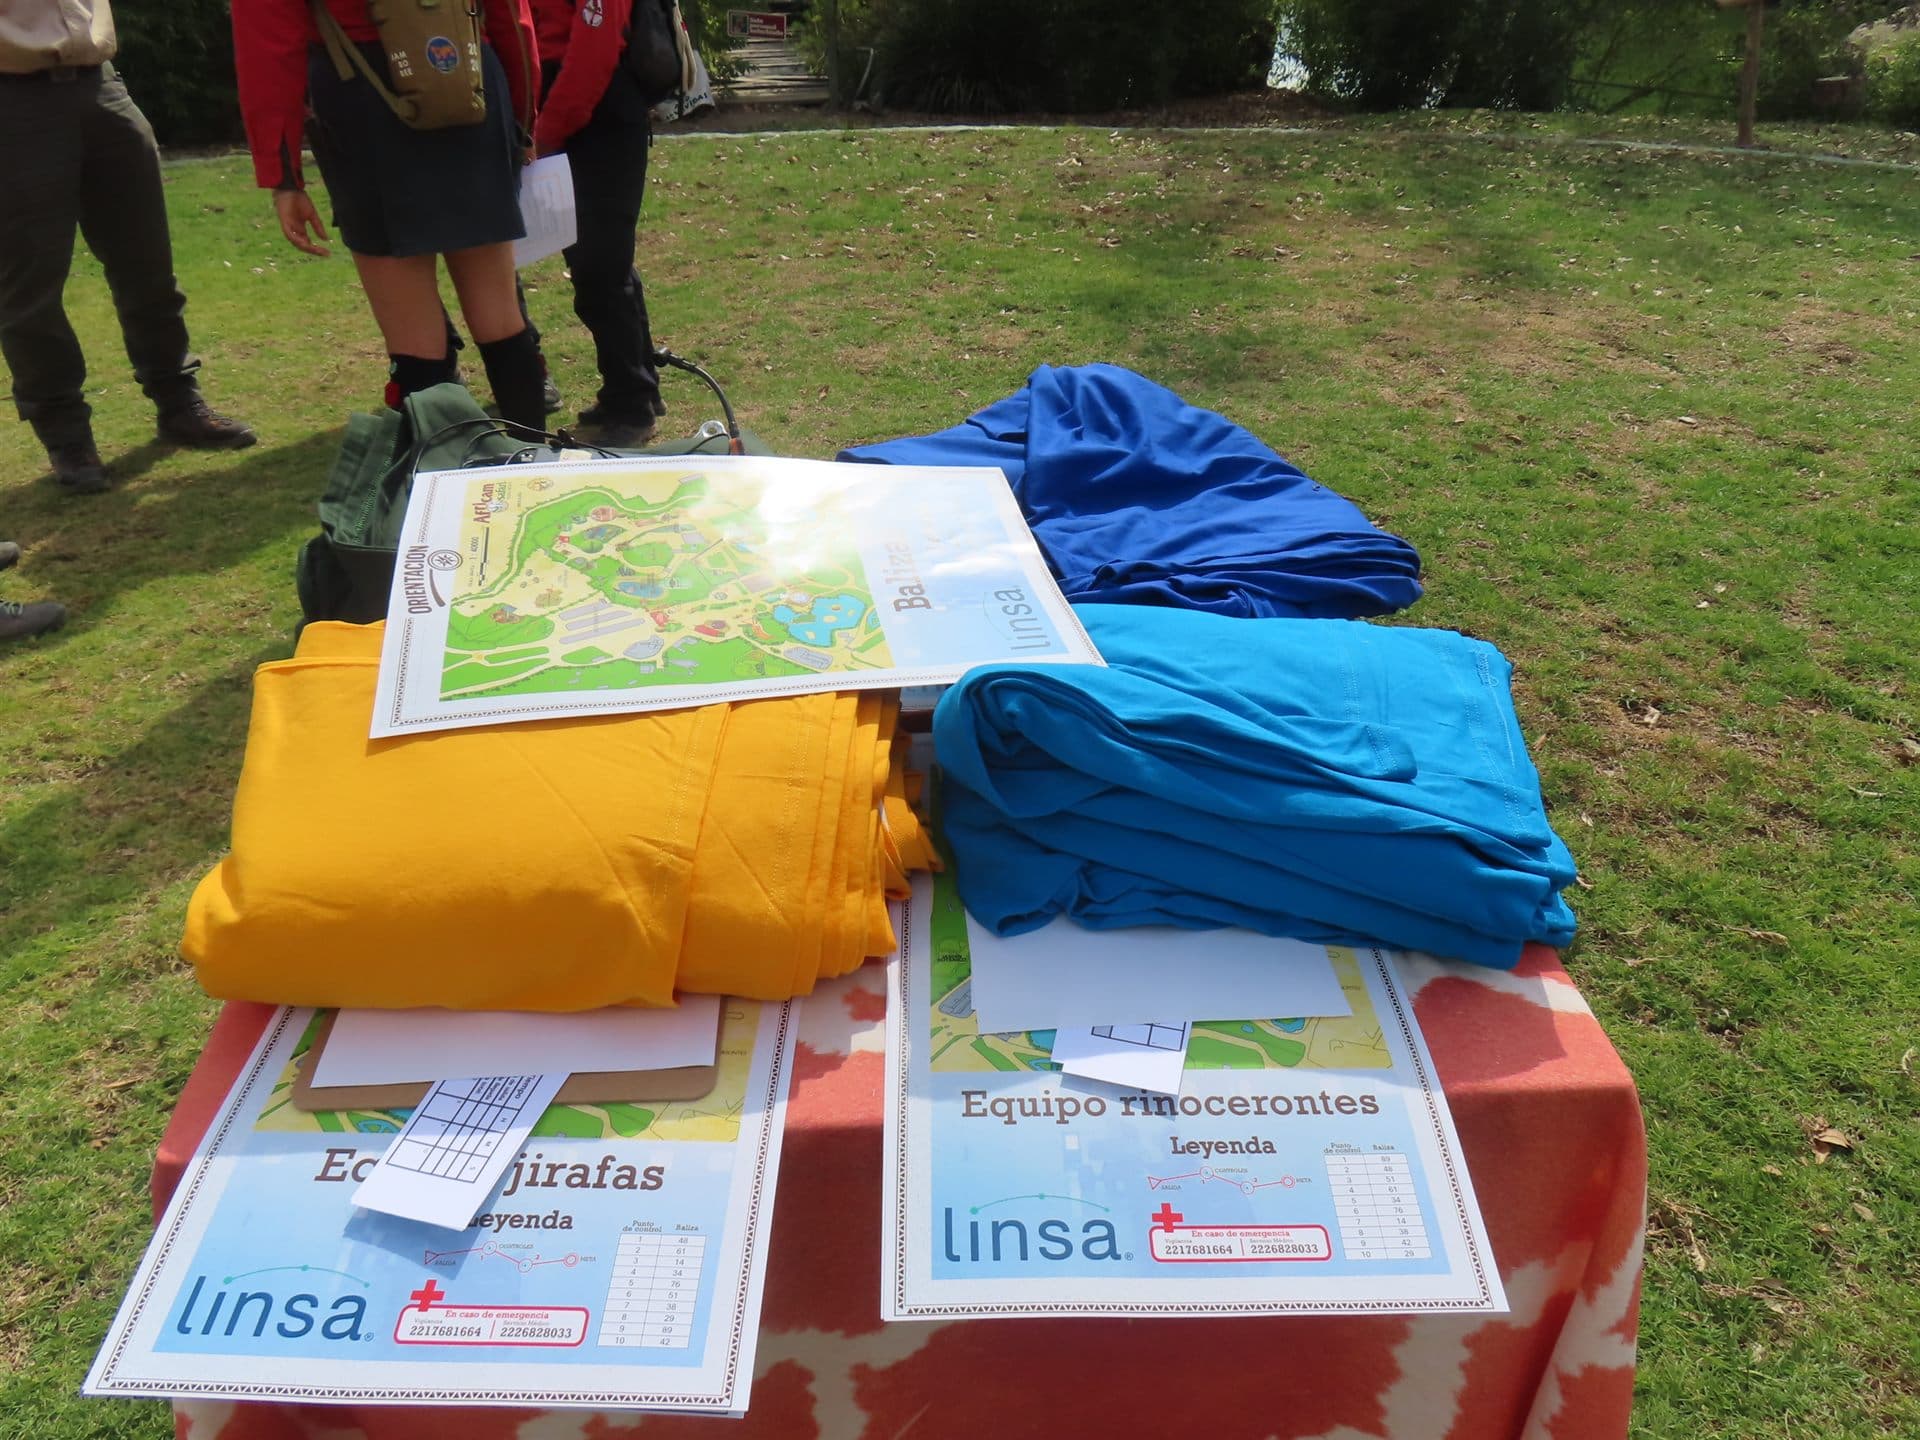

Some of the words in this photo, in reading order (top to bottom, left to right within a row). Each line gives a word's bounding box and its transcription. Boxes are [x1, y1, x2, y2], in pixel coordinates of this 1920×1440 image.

[961, 1090, 1107, 1125] Equipo
[1119, 1089, 1380, 1117] rinocerontes
[1169, 1136, 1277, 1159] Leyenda
[503, 1152, 665, 1197] jirafas
[632, 1220, 654, 1228] Punto
[945, 1207, 1122, 1262] linsa
[1239, 1230, 1290, 1238] emergencia
[1165, 1245, 1233, 1255] 2217681664
[1251, 1244, 1319, 1254] 2226828033
[176, 1276, 367, 1341] linsa
[445, 1310, 457, 1318] En
[494, 1312, 549, 1320] emergencia
[409, 1326, 481, 1337] 2217681664
[500, 1327, 572, 1338] 2226828033
[660, 1338, 671, 1346] 42
